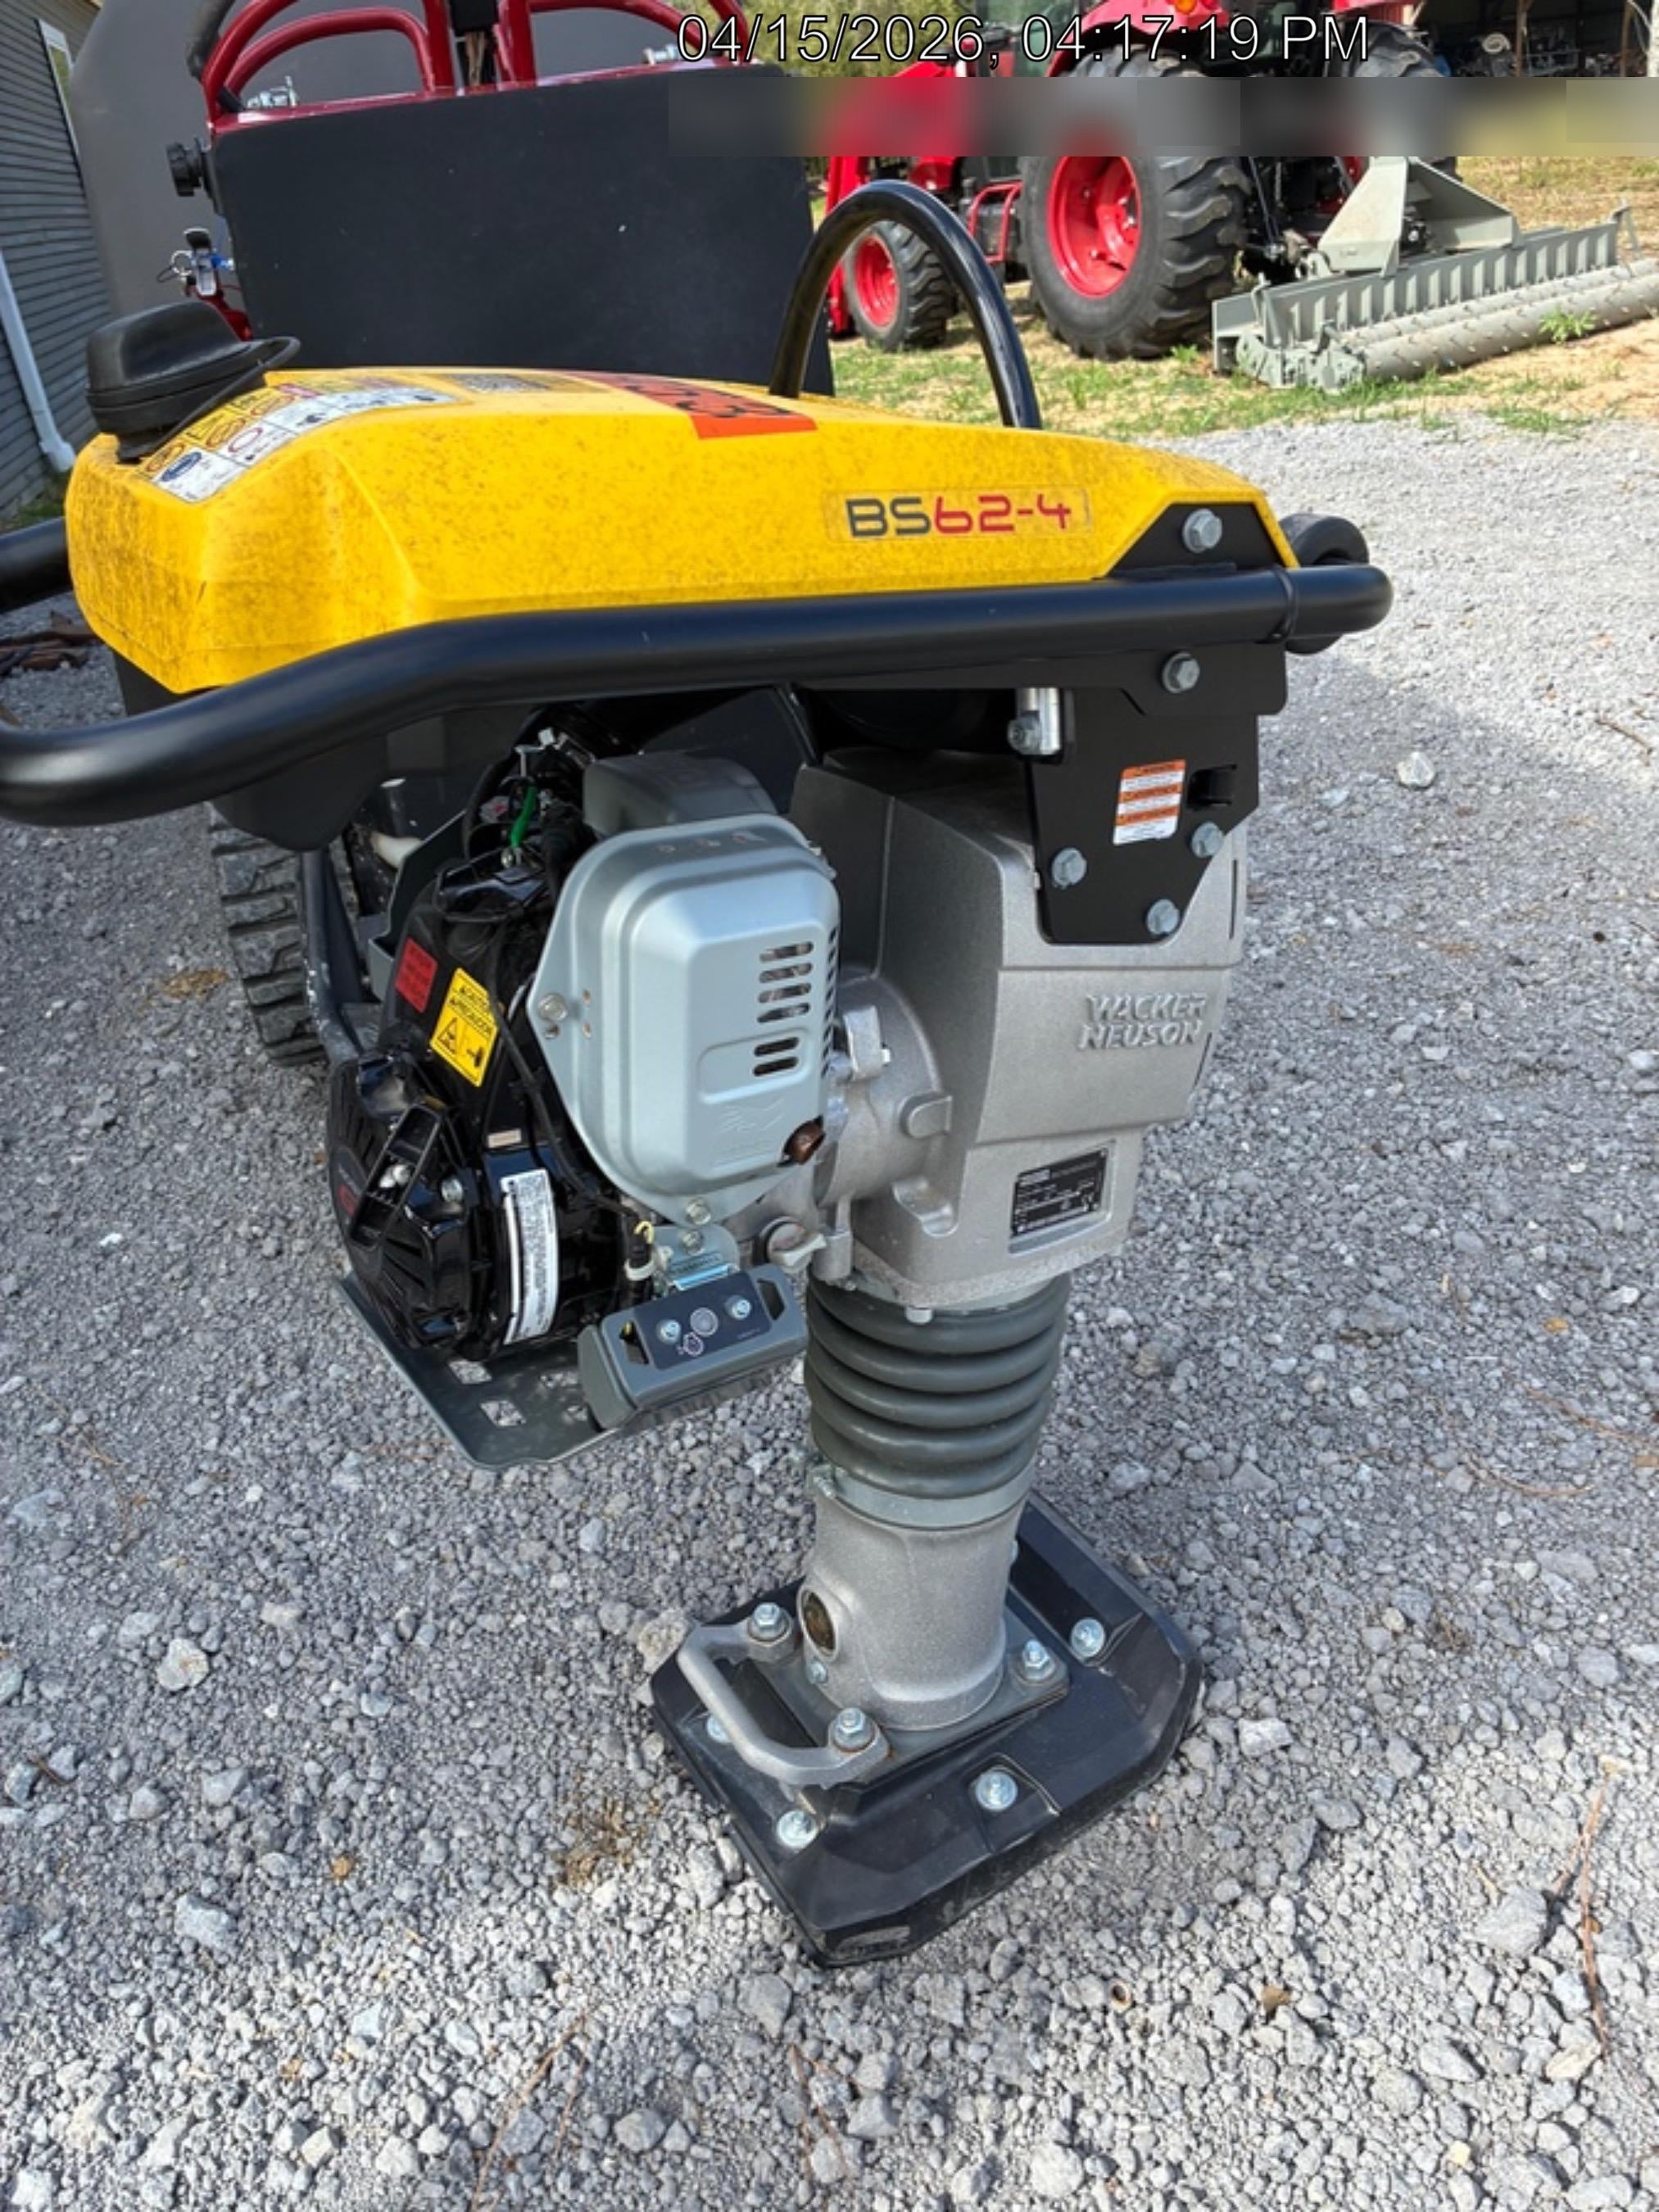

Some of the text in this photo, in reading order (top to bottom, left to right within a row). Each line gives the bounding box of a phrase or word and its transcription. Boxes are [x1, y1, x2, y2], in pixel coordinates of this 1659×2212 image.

[845, 493, 1071, 537] BS62-4
[1086, 992, 1206, 1021] WACKER
[1077, 1019, 1203, 1050] NEUSON
